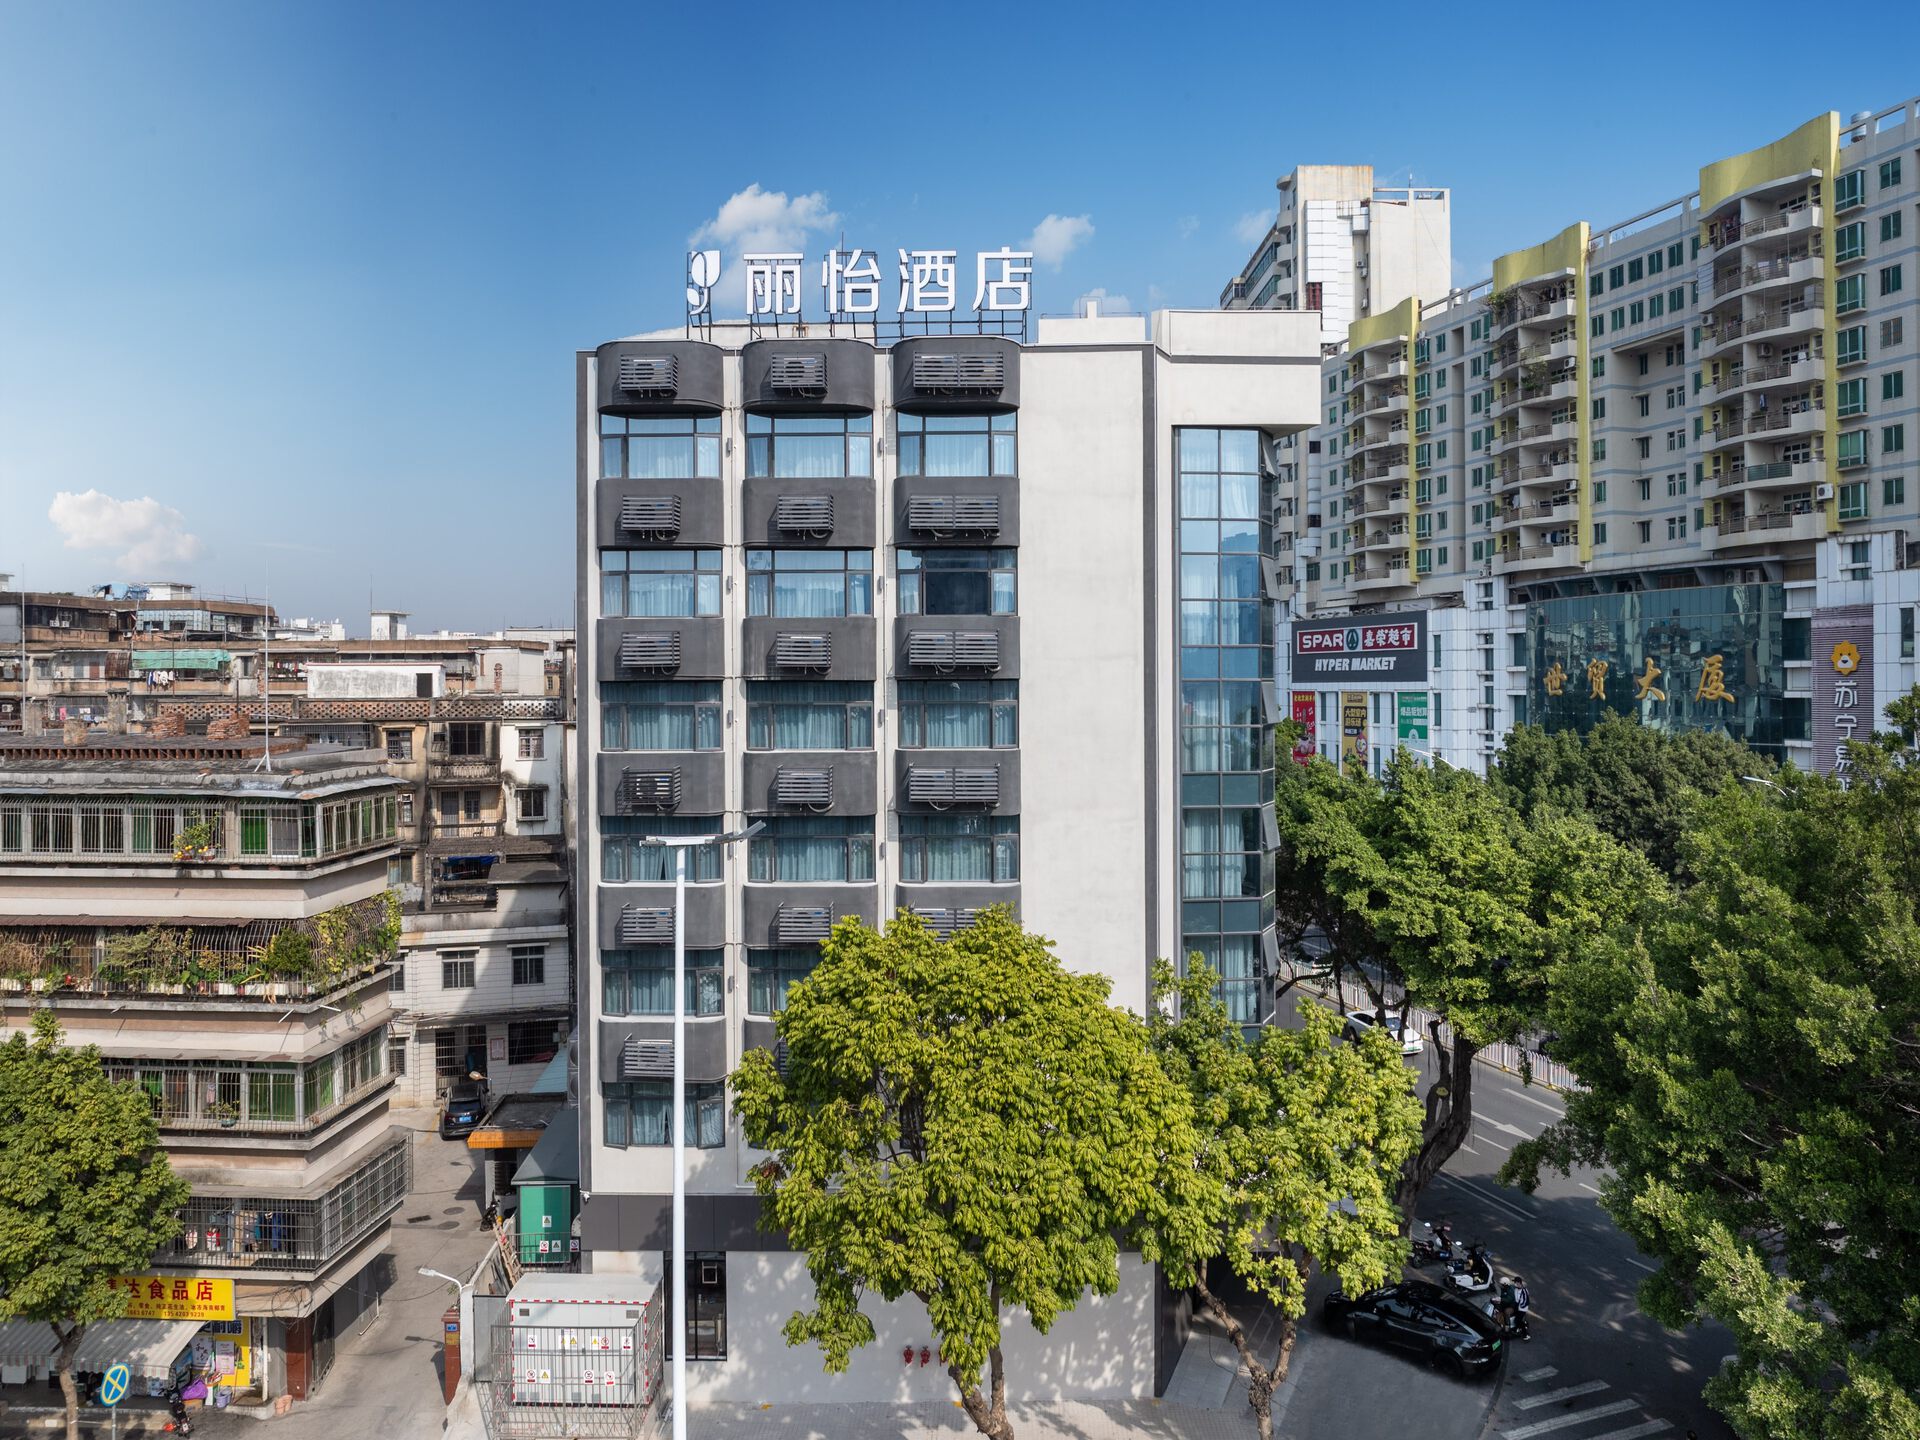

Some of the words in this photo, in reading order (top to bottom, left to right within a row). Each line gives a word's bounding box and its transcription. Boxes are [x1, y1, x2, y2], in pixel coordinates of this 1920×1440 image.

[743, 247, 1034, 315] 丽怡酒店
[1302, 633, 1343, 649] SPAR
[1315, 657, 1349, 671] HYPER
[1351, 656, 1396, 671] MARKET
[1834, 680, 1858, 792] 苏宁易
